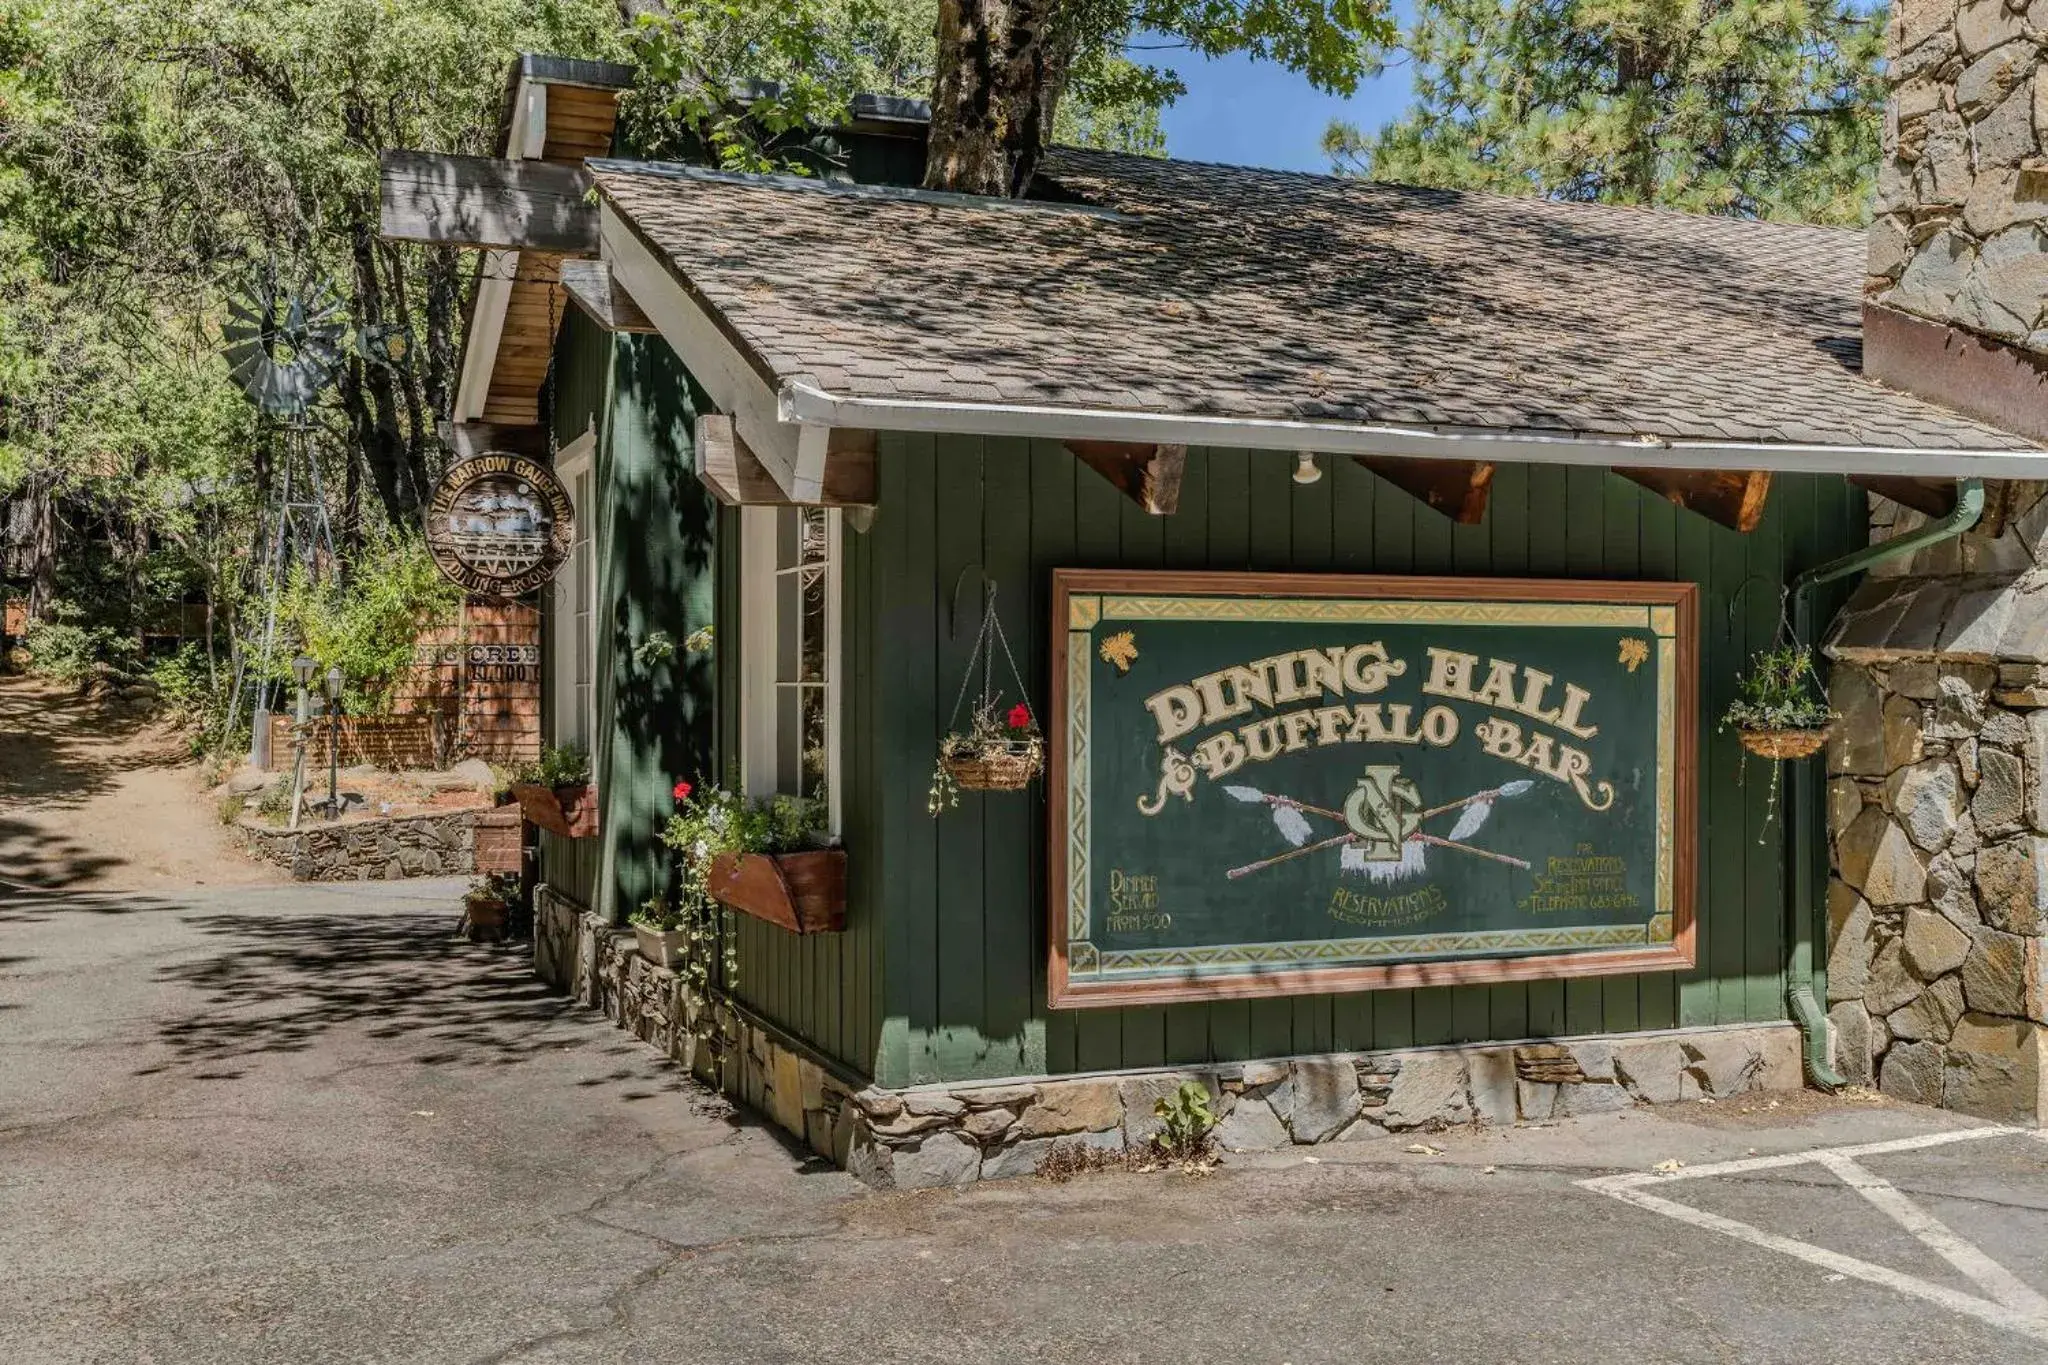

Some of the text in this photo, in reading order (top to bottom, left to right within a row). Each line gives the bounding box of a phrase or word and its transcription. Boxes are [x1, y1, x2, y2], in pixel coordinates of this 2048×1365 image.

[431, 457, 571, 522] THE NARROW GAUGE INN
[449, 563, 552, 593] DINING ROOM
[1143, 640, 1600, 745] DINING HALL
[1136, 703, 1615, 816] & BUFFALO BAR
[1110, 868, 1158, 893] DINNER
[1110, 892, 1159, 914] SERVED
[1331, 884, 1442, 916] RESERVATIONS
[1106, 914, 1141, 932] FROM
